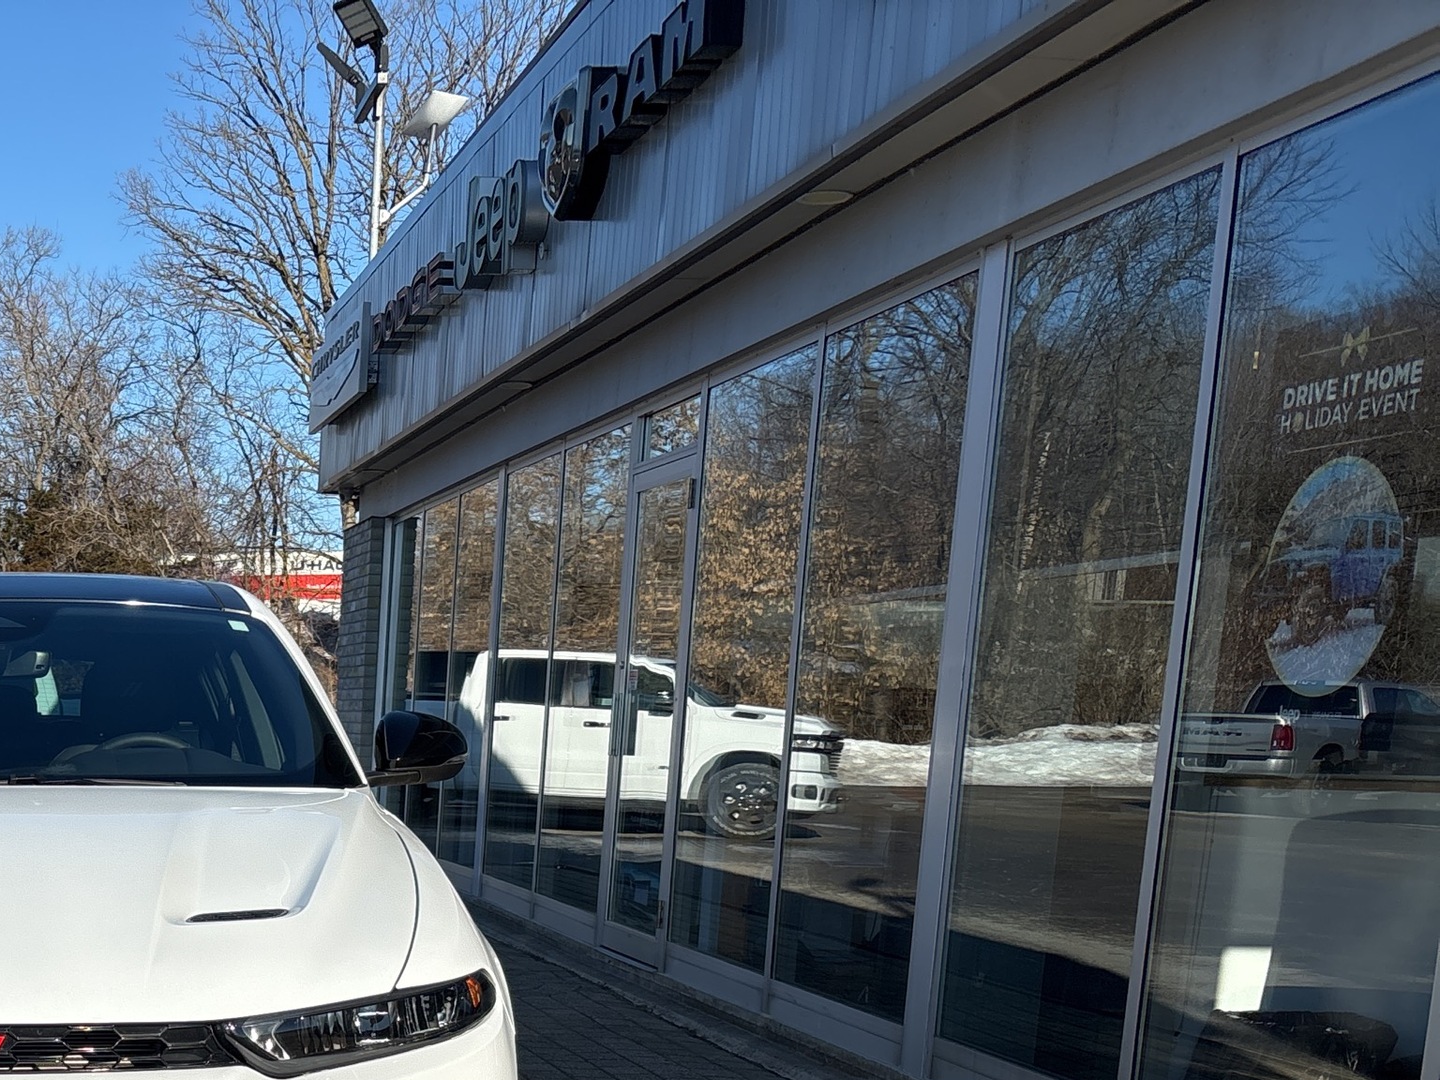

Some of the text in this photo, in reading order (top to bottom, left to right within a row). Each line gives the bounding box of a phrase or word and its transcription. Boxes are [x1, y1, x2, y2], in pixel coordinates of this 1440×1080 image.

[588, 0, 707, 152] RAM
[455, 159, 527, 291] Jeep
[371, 252, 452, 355] DODGE
[312, 320, 360, 381] CHRYSLER
[1279, 388, 1421, 435] HOLIDAY EVENT
[1283, 358, 1425, 410] DRIVE IT HOME
[1276, 704, 1301, 724] Jeep
